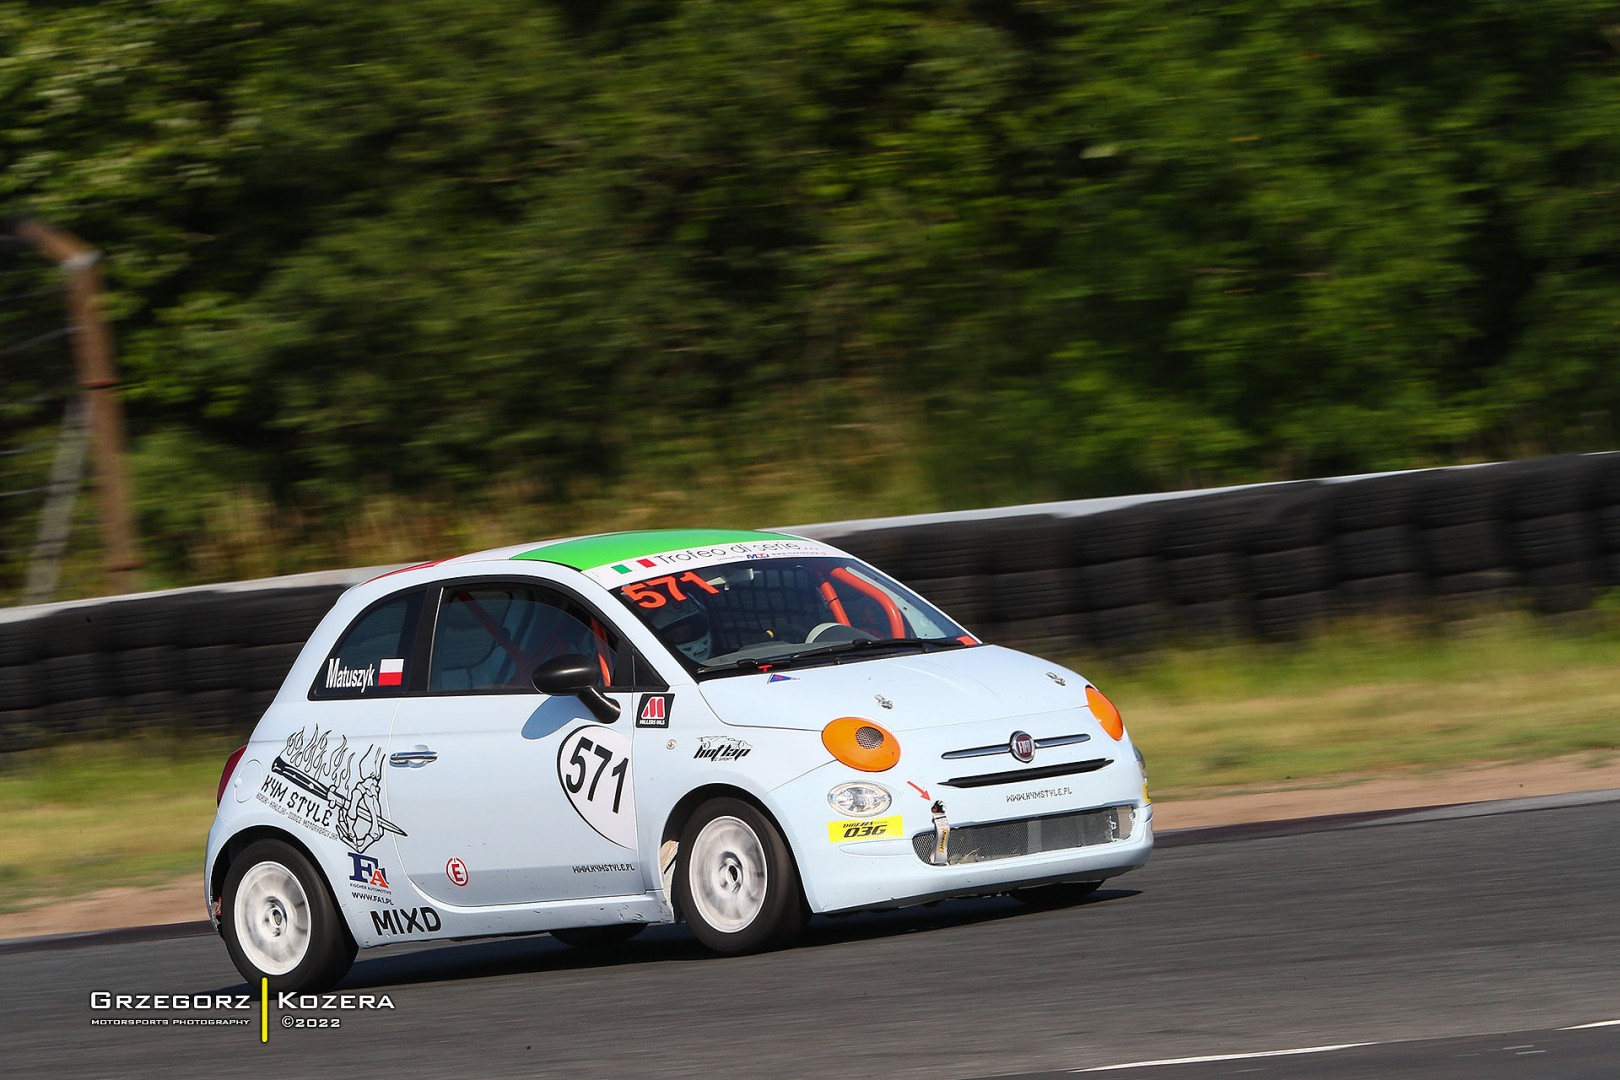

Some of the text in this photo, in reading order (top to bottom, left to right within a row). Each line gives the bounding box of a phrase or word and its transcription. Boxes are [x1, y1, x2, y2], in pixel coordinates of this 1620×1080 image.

[653, 547, 726, 564] Trofeo
[730, 543, 752, 554] di
[621, 571, 720, 609] 571
[325, 657, 375, 693] Matuszyk
[1017, 739, 1031, 754] FIAT
[565, 736, 629, 814] 571
[287, 791, 333, 827] STYLE
[843, 825, 888, 838] 03G
[451, 863, 465, 882] E
[370, 906, 442, 936] MIXD
